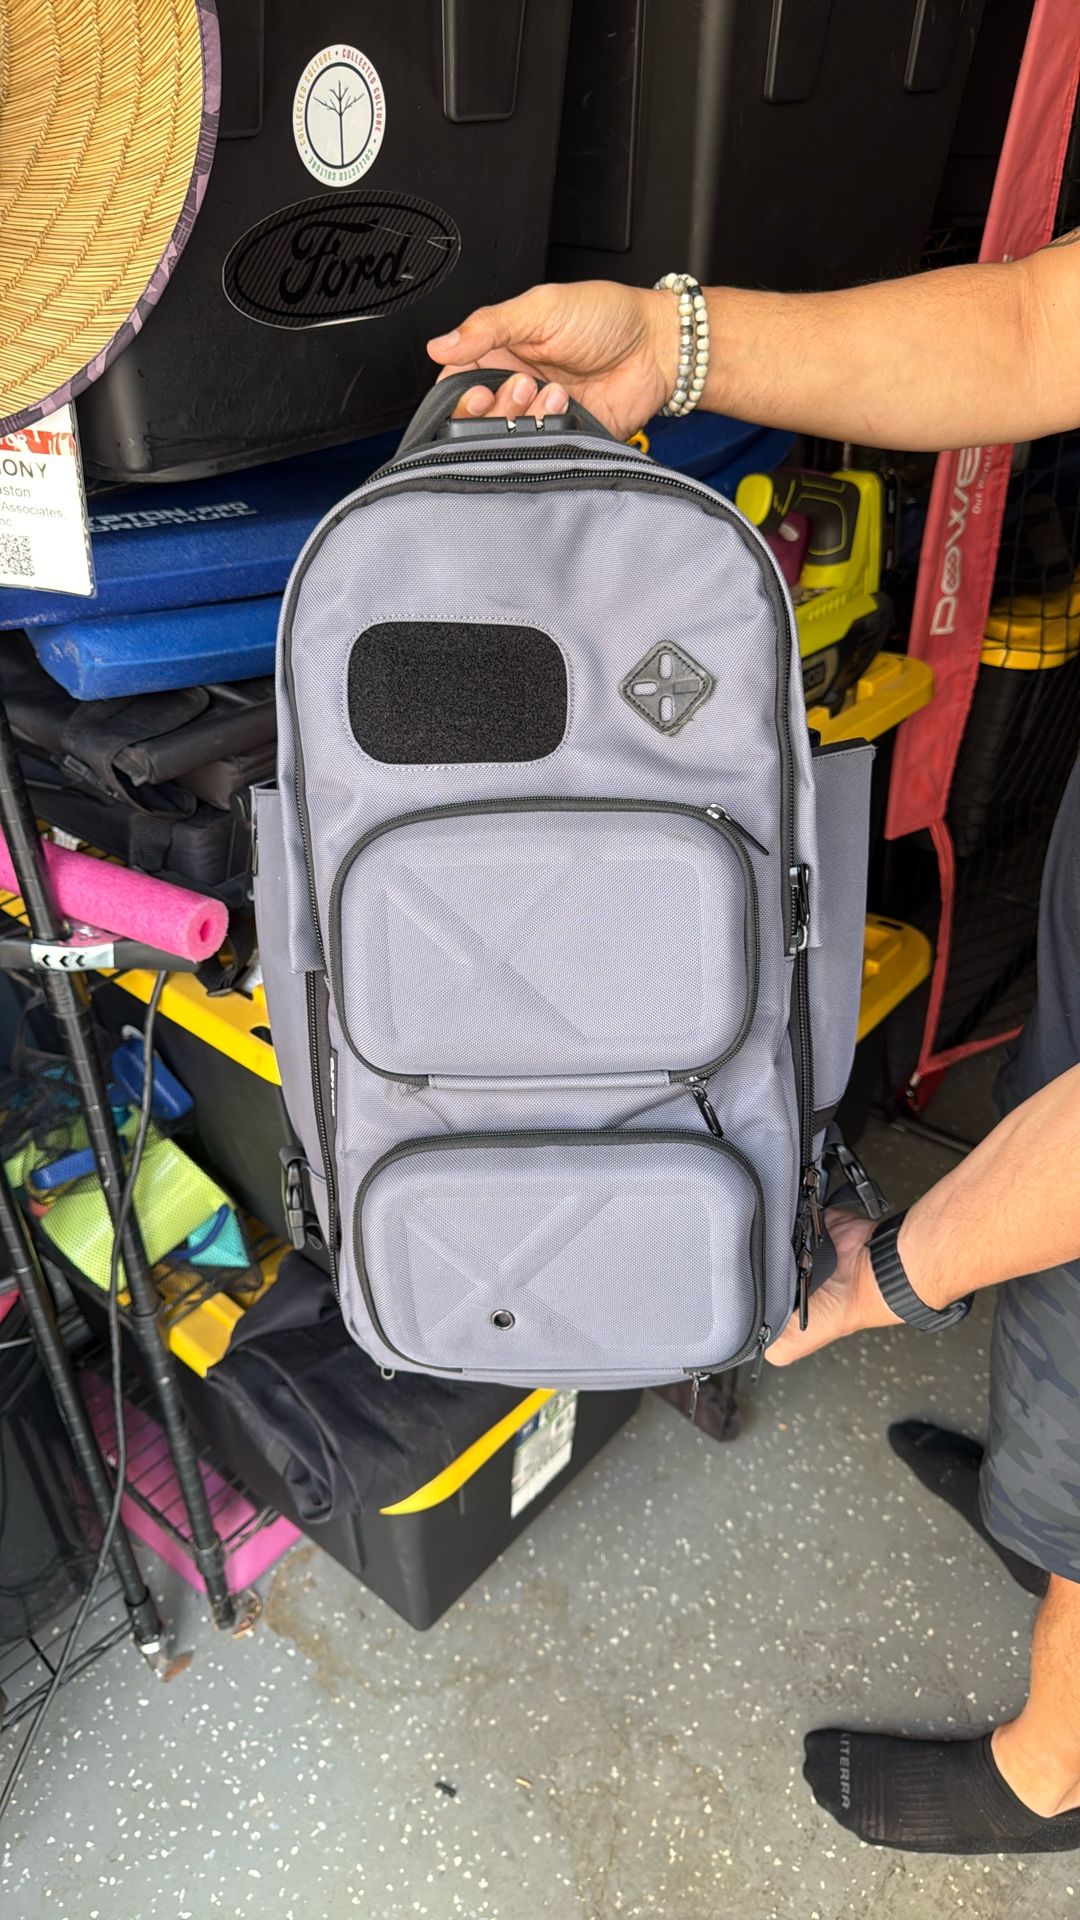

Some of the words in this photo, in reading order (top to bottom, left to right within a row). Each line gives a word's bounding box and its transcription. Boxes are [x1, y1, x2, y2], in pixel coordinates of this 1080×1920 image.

[296, 86, 307, 146] COLLECTED
[304, 50, 333, 84] CULTURE
[342, 48, 376, 85] COLLECTED
[373, 87, 383, 133] CULTURE
[339, 148, 374, 181] COLLECTED
[279, 217, 413, 305] Ford
[0, 458, 47, 479] ONY
